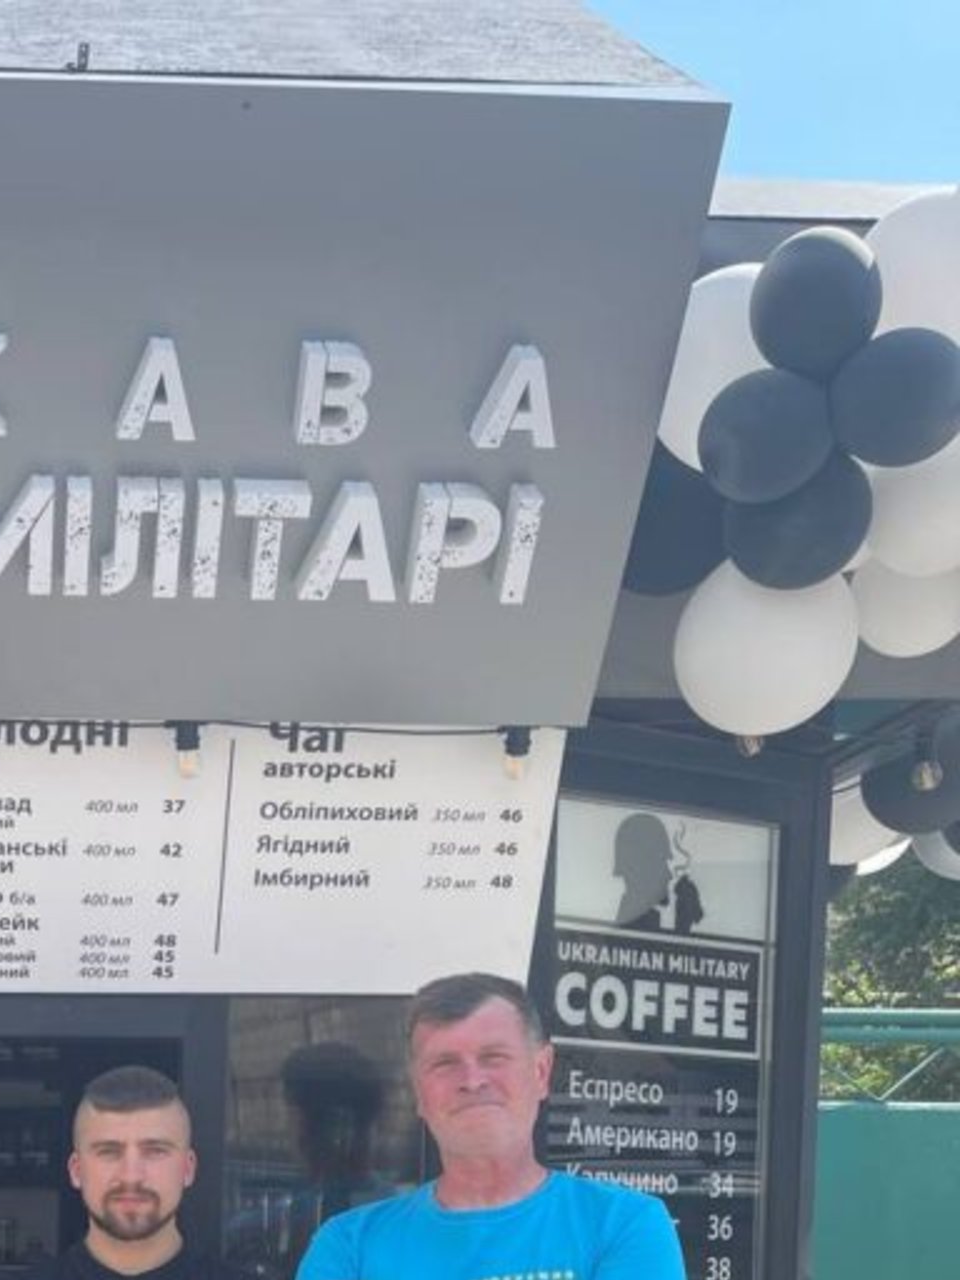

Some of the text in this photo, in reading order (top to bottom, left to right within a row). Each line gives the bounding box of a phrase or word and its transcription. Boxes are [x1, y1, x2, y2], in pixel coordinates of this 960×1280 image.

[263, 759, 397, 783] авторські
[162, 800, 185, 814] 37
[259, 801, 419, 821] Обліпиховий
[499, 809, 523, 823] 46
[159, 844, 183, 857] 42
[256, 836, 351, 856] Ягідний
[494, 843, 518, 856] 46
[253, 868, 371, 890] Імбирний
[489, 876, 514, 889] 48
[156, 893, 180, 906] 47
[153, 934, 177, 948] 48
[153, 950, 175, 963] 45
[557, 941, 750, 981] UKRAINIAN MILITARY
[151, 965, 174, 979] 45
[555, 971, 749, 1040] COFFEE
[568, 1069, 739, 1114] Еспресо 19
[566, 1116, 736, 1156] Американо 19
[709, 1172, 734, 1198] 34
[707, 1215, 733, 1240] 36
[705, 1256, 731, 1280] 38
